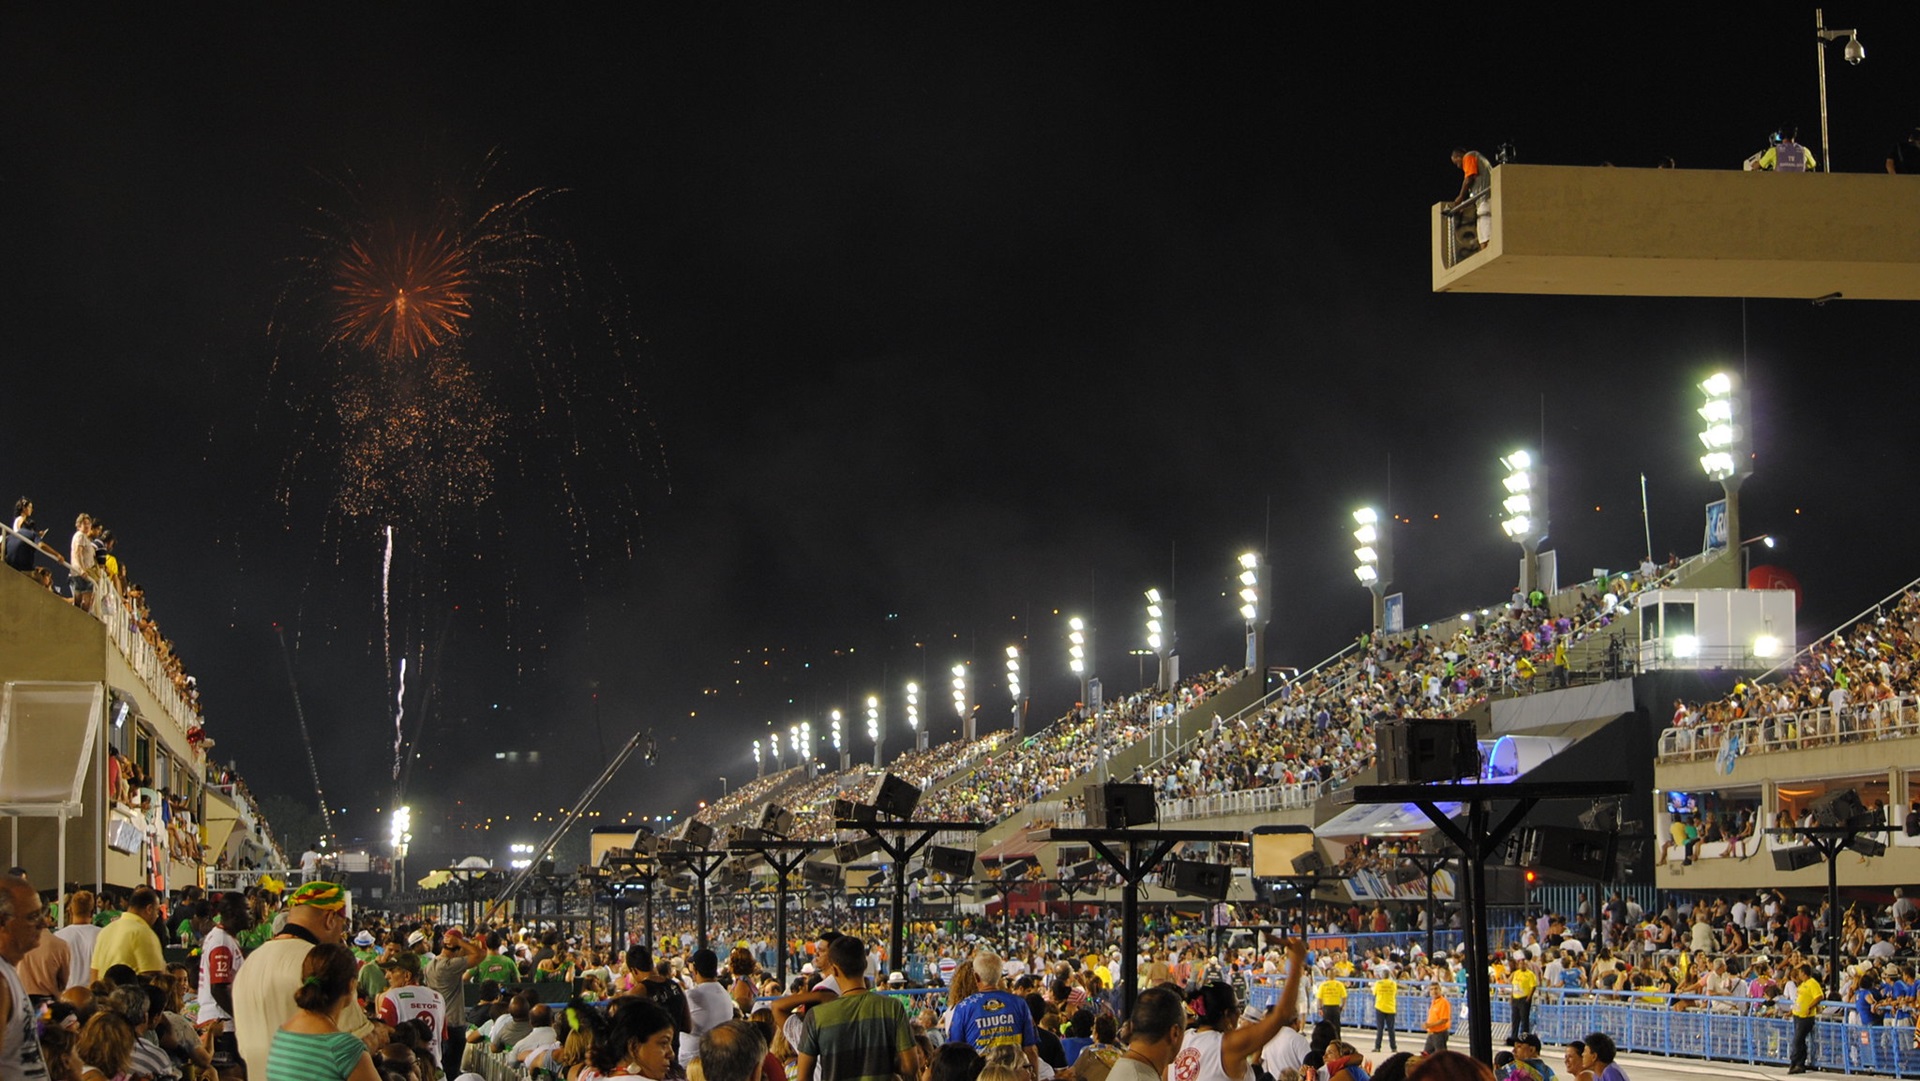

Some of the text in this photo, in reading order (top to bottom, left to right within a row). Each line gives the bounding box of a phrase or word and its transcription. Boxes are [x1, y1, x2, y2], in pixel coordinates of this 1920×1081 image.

[216, 960, 229, 972] 12
[410, 1002, 438, 1010] SETOR
[975, 1014, 1015, 1029] TIJUCA
